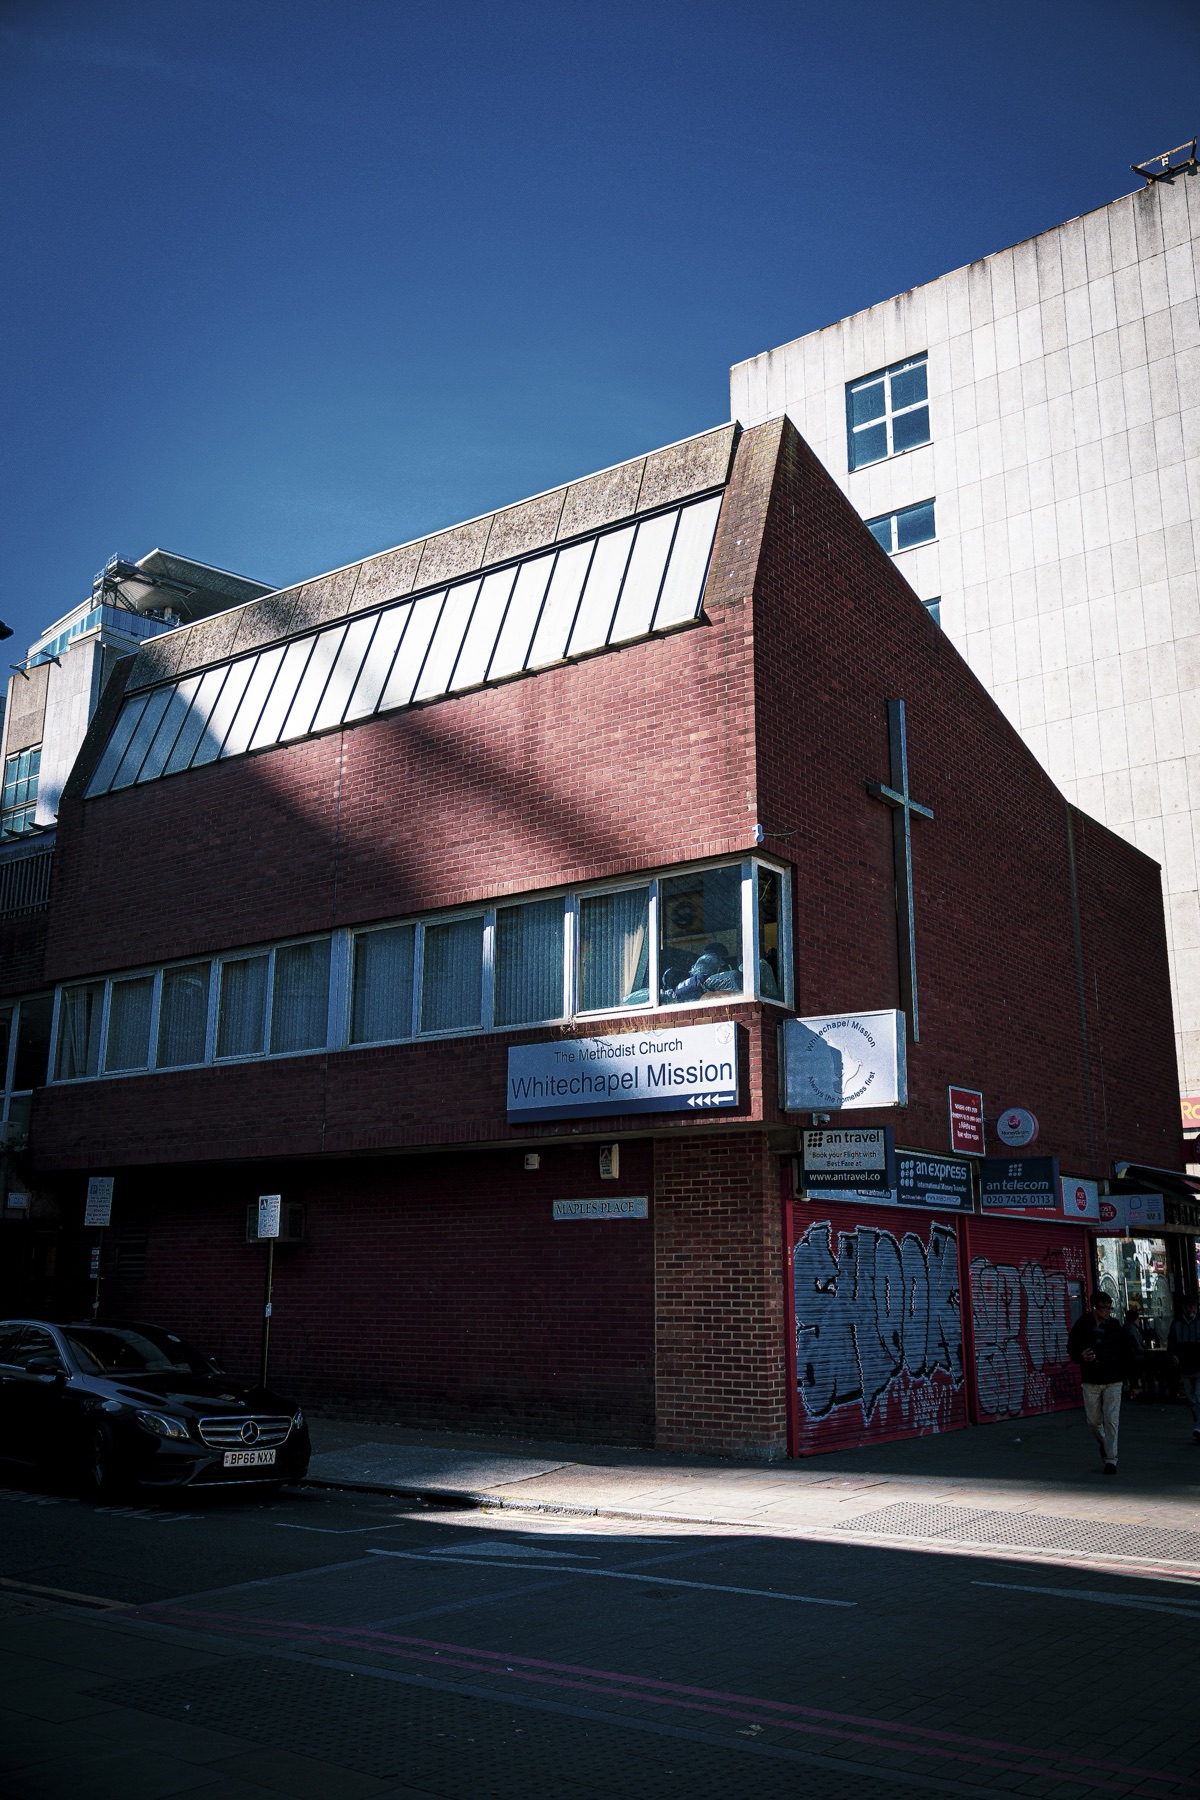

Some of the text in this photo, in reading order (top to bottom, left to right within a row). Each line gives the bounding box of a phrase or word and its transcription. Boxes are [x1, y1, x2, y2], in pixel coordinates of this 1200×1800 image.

[806, 1020, 876, 1052] Whitechapel Mission
[554, 1038, 683, 1064] The Methodist Church
[511, 1060, 732, 1099] Whitechapel Mission
[808, 1071, 876, 1103] Always the homeless first
[826, 1131, 880, 1143] an travel
[828, 1152, 842, 1160] your
[843, 1151, 862, 1159] Flight
[809, 1171, 881, 1181] www.antravel.co
[916, 1161, 967, 1181] an express
[986, 1180, 1049, 1190] an telecom
[986, 1195, 1051, 1204] 020 7426 0113
[556, 1202, 634, 1214] MAPLES PLACE
[230, 1451, 274, 1464] BP66 NXX
